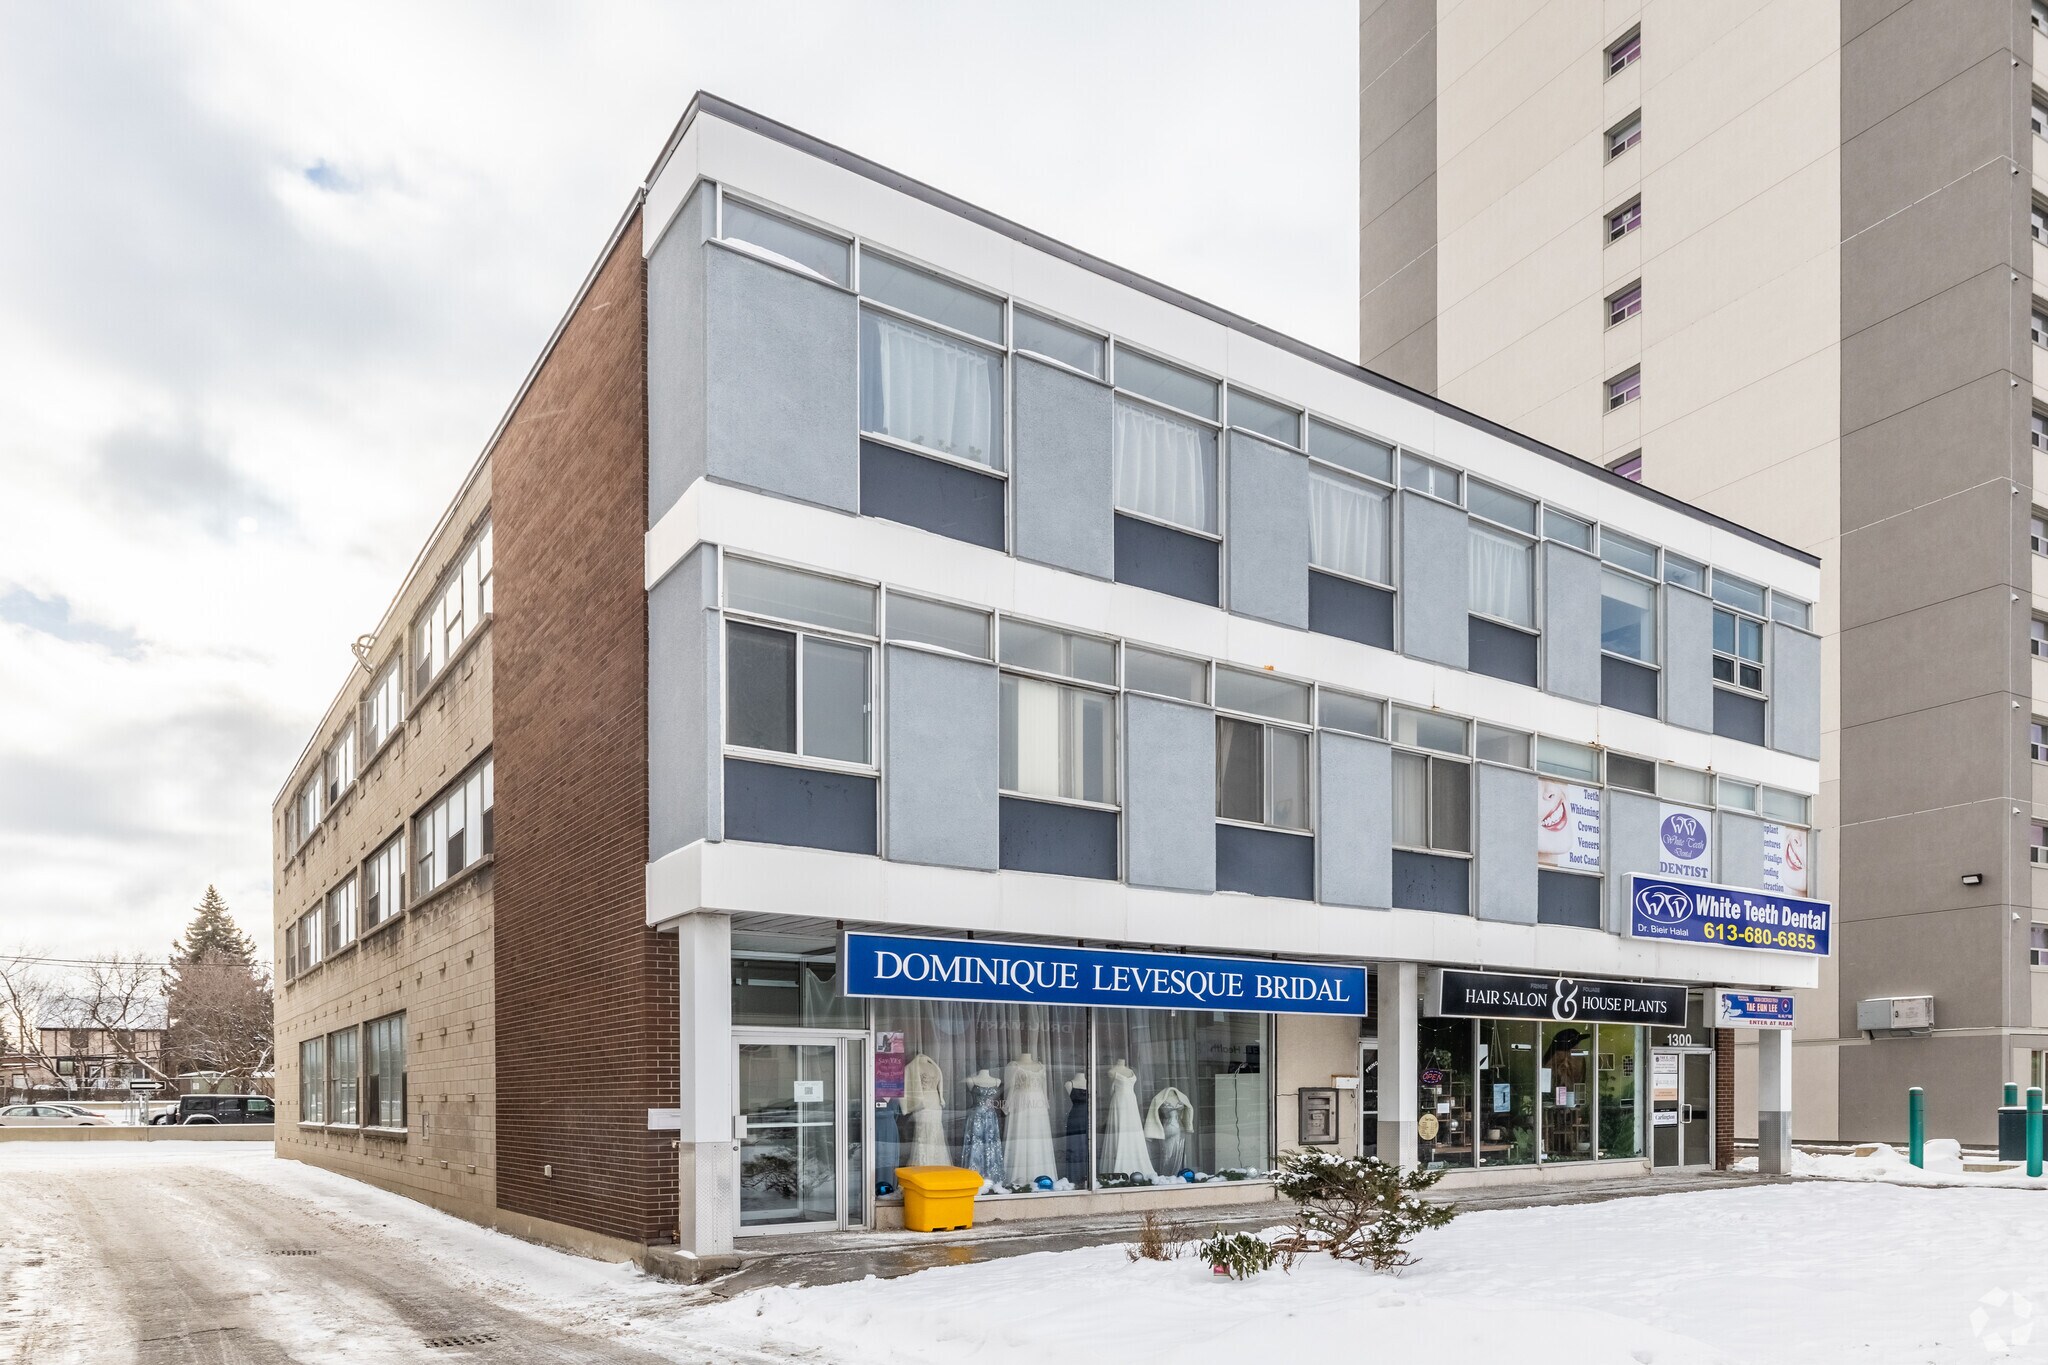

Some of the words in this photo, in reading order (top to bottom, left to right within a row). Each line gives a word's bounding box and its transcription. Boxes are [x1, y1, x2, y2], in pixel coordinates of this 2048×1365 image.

[1584, 789, 1600, 801] Teeth
[1570, 803, 1600, 820] Whitening
[1578, 821, 1600, 834] Crowns
[1764, 824, 1779, 835] plant
[1578, 837, 1600, 850] Veneers
[1663, 834, 1685, 847] White
[1686, 837, 1704, 850] Teeth
[1764, 839, 1781, 850] entures
[1569, 852, 1583, 864] Root
[1584, 854, 1600, 866] Canal
[1674, 848, 1693, 858] Dental
[1764, 853, 1783, 865] visalign
[1660, 862, 1709, 878] DENTIST
[1696, 894, 1741, 920] White
[1744, 900, 1778, 925] Teeth
[1782, 906, 1826, 931] Dental
[1637, 923, 1649, 933] Dr.
[1670, 926, 1689, 937] Halal
[1703, 922, 1816, 950] 613-680-6855
[874, 950, 1079, 994] DOMINIQUE
[1092, 964, 1244, 1001] LEVESQUE
[1255, 975, 1351, 1002] BRIDAL
[1465, 988, 1500, 1005] HAIR
[1502, 991, 1548, 1007] SALON
[1552, 977, 1579, 1022] &
[1582, 996, 1622, 1011] HOUSE
[1624, 998, 1667, 1013] PLANTS
[1768, 1003, 1778, 1013] LEE
[1667, 1034, 1692, 1046] 1300
[1422, 1073, 1444, 1081] OPEN
